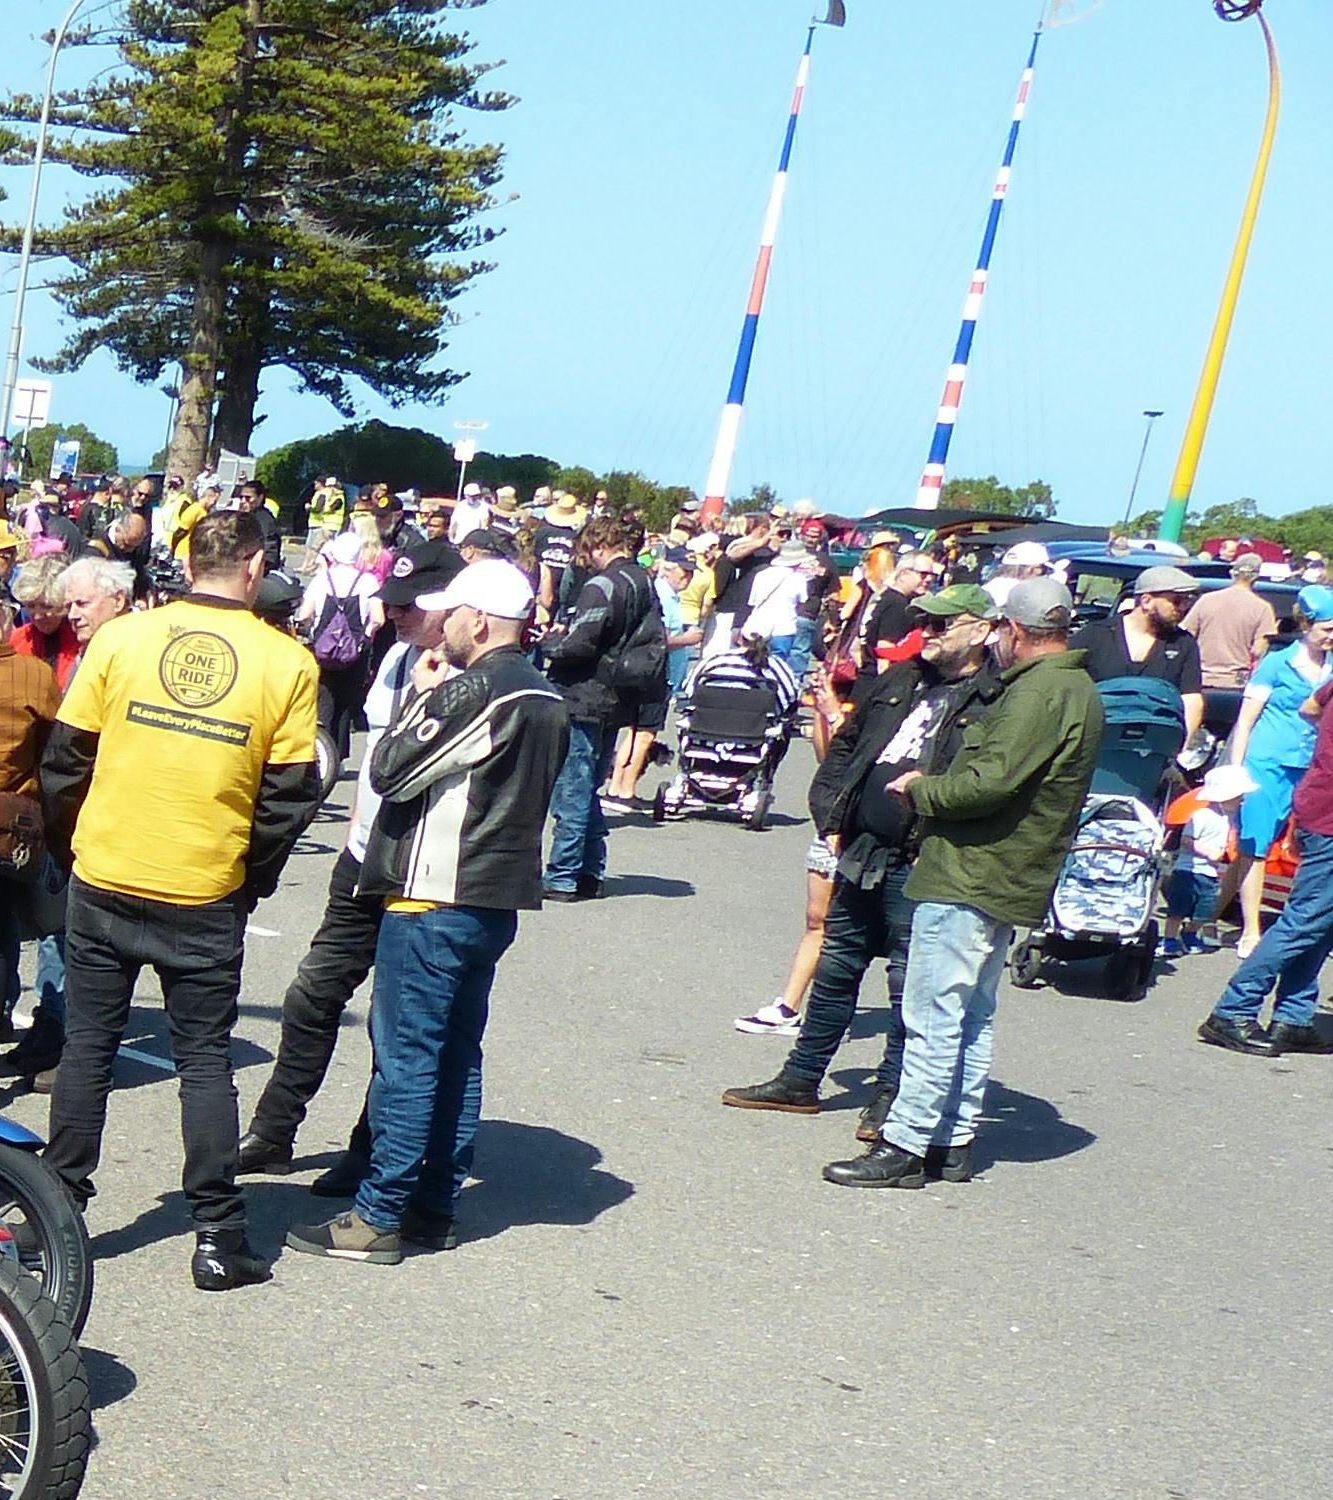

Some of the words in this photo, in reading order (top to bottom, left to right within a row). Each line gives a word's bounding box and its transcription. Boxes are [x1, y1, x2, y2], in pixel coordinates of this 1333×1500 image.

[185, 652, 218, 670] ONE
[178, 668, 215, 687] RIDE
[131, 706, 247, 740] #LeaveEveryPlaceBetter
